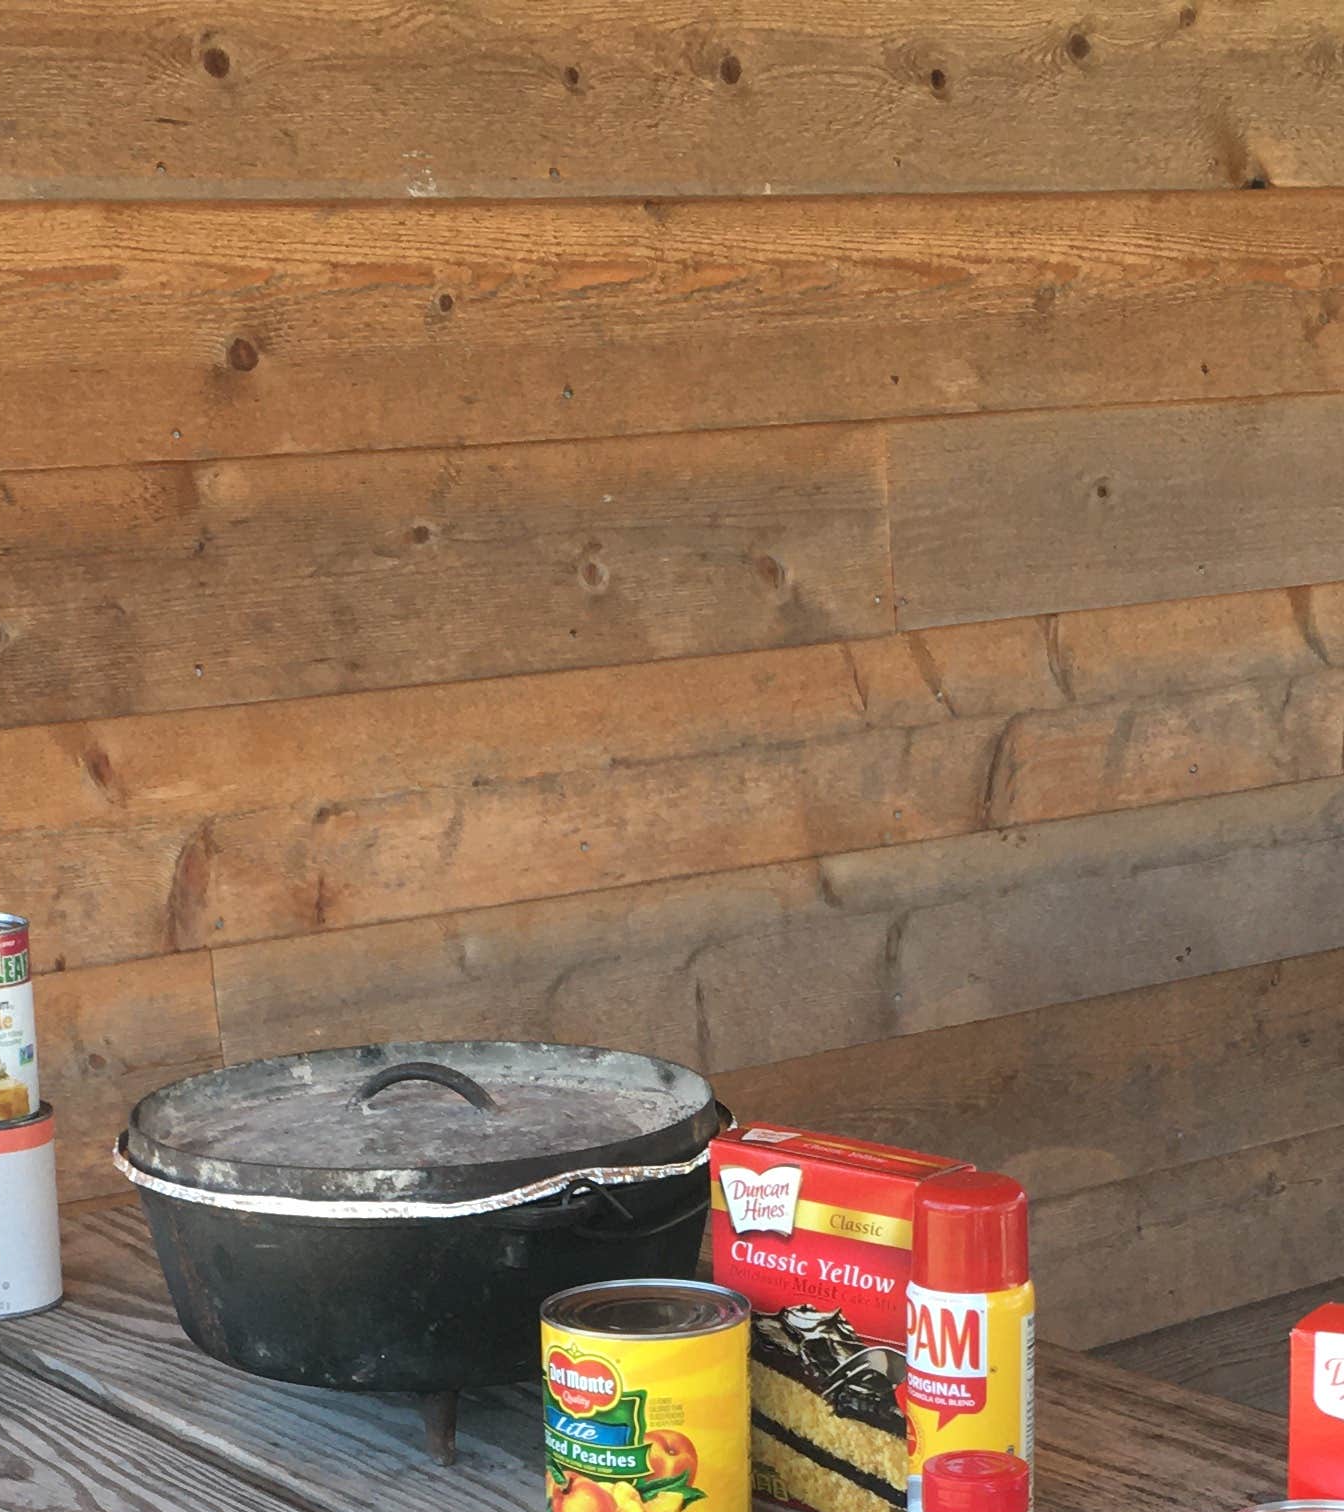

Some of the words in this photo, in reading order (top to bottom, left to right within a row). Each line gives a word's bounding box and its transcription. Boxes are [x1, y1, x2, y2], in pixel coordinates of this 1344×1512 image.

[727, 1179, 790, 1201] Duncan
[740, 1200, 786, 1221] Hines
[829, 1213, 884, 1237] Classic
[731, 1240, 809, 1276] Classic
[816, 1258, 896, 1294] Yellow
[792, 1277, 838, 1300] Moist
[549, 1362, 567, 1385] Del
[567, 1370, 615, 1395] Monte
[907, 1373, 972, 1397] ORIGINAL
[562, 1391, 591, 1408] Quality
[948, 1399, 976, 1407] BLEND
[555, 1416, 599, 1440] Lite
[572, 1444, 636, 1467] Peaches
